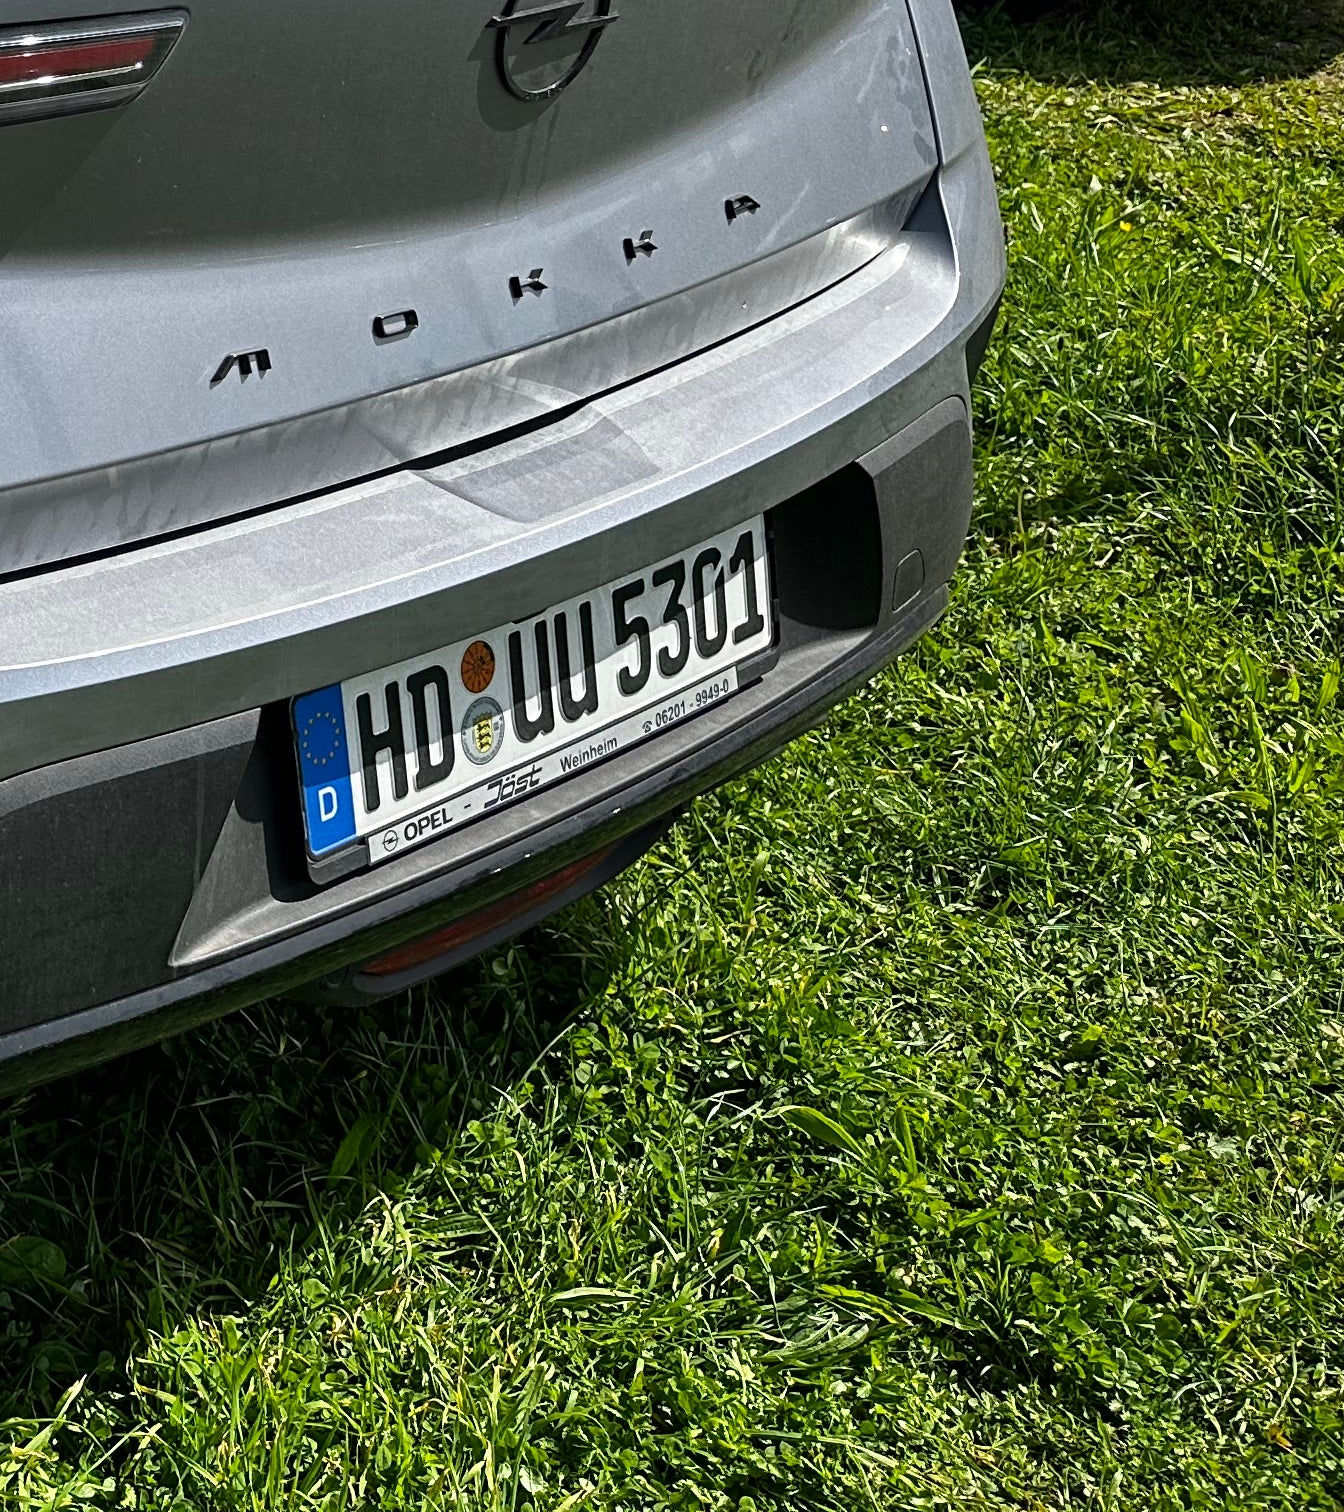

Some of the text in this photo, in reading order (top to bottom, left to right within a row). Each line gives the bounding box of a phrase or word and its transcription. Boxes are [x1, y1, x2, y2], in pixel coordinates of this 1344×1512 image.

[355, 664, 456, 814] HD
[507, 600, 600, 744] UU
[611, 529, 766, 697] 5301
[318, 785, 339, 823] D
[403, 808, 454, 842] OPEL
[483, 763, 544, 810] Jöst
[559, 737, 619, 773] Weinheim
[654, 700, 686, 728] 06201
[695, 678, 730, 709] 9949-0
